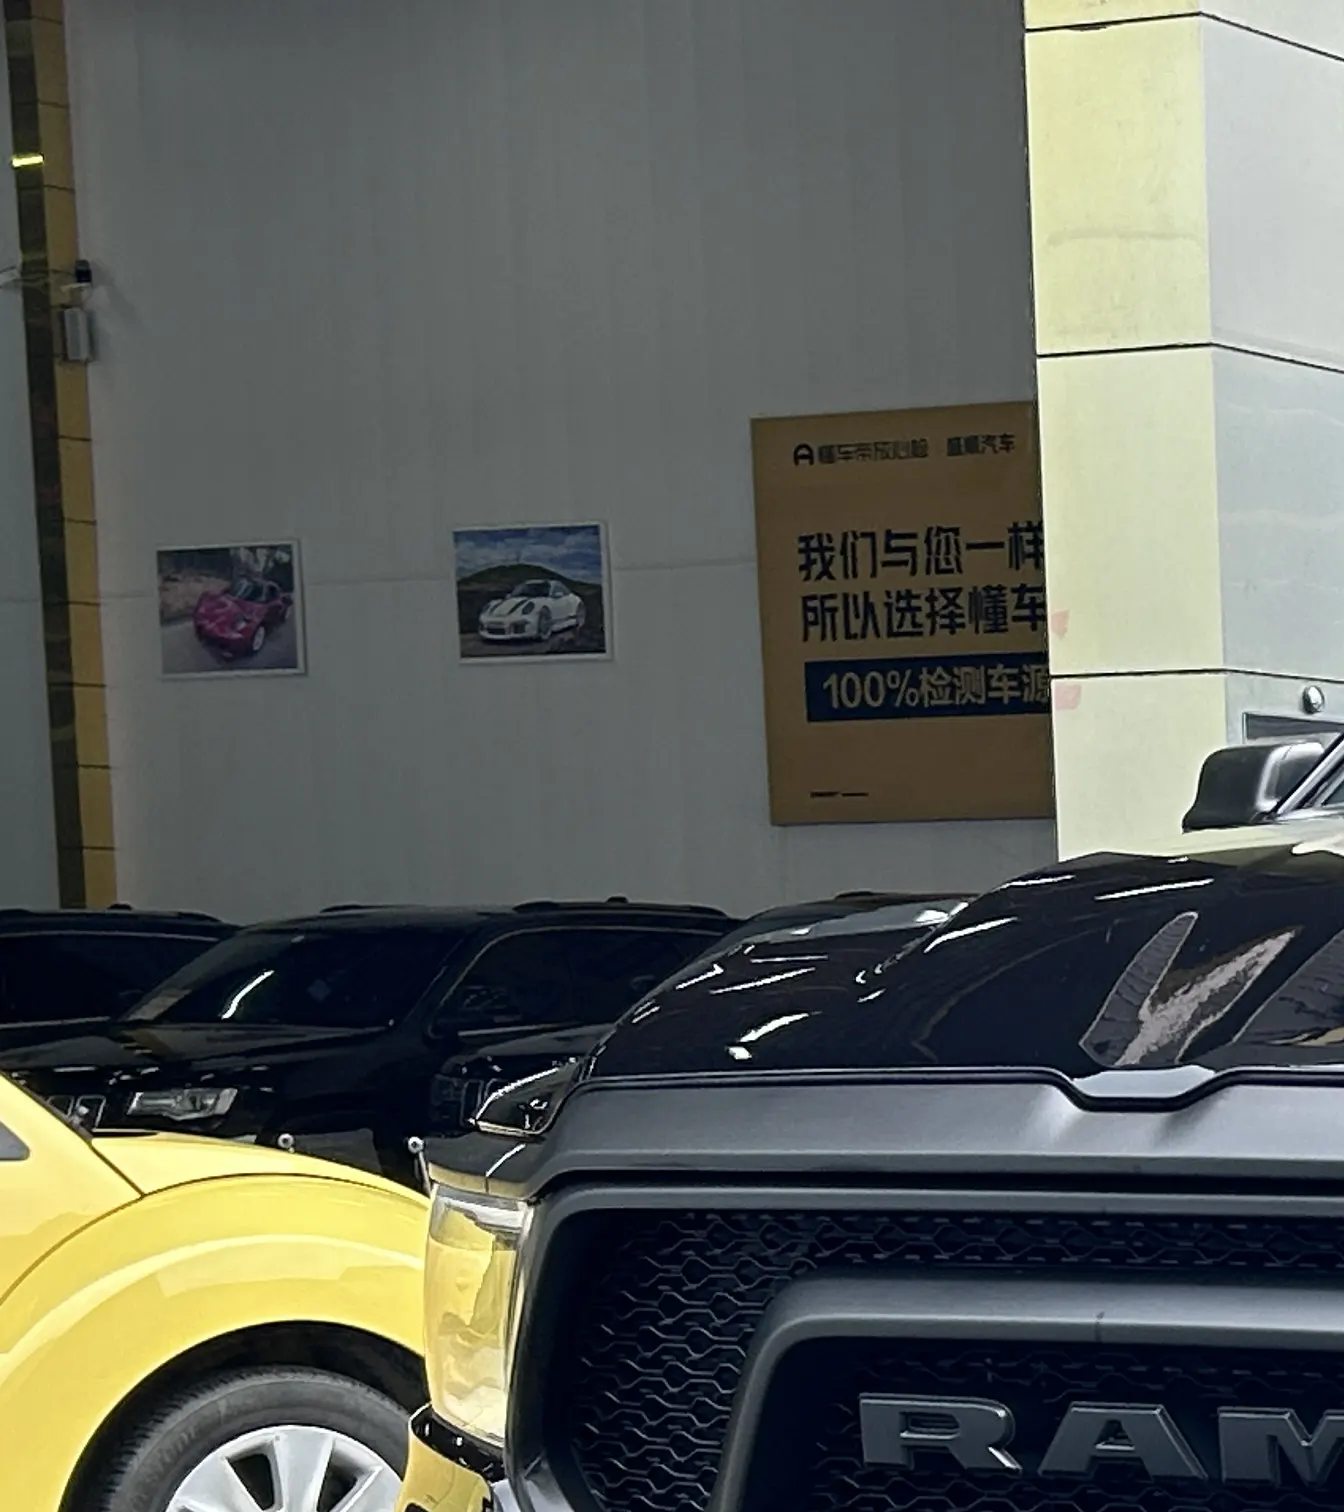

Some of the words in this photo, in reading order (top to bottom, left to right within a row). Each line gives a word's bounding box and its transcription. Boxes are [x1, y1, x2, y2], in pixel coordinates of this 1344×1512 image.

[797, 521, 1043, 582] 我们与您一样
[801, 583, 1047, 643] 所以选择懂车
